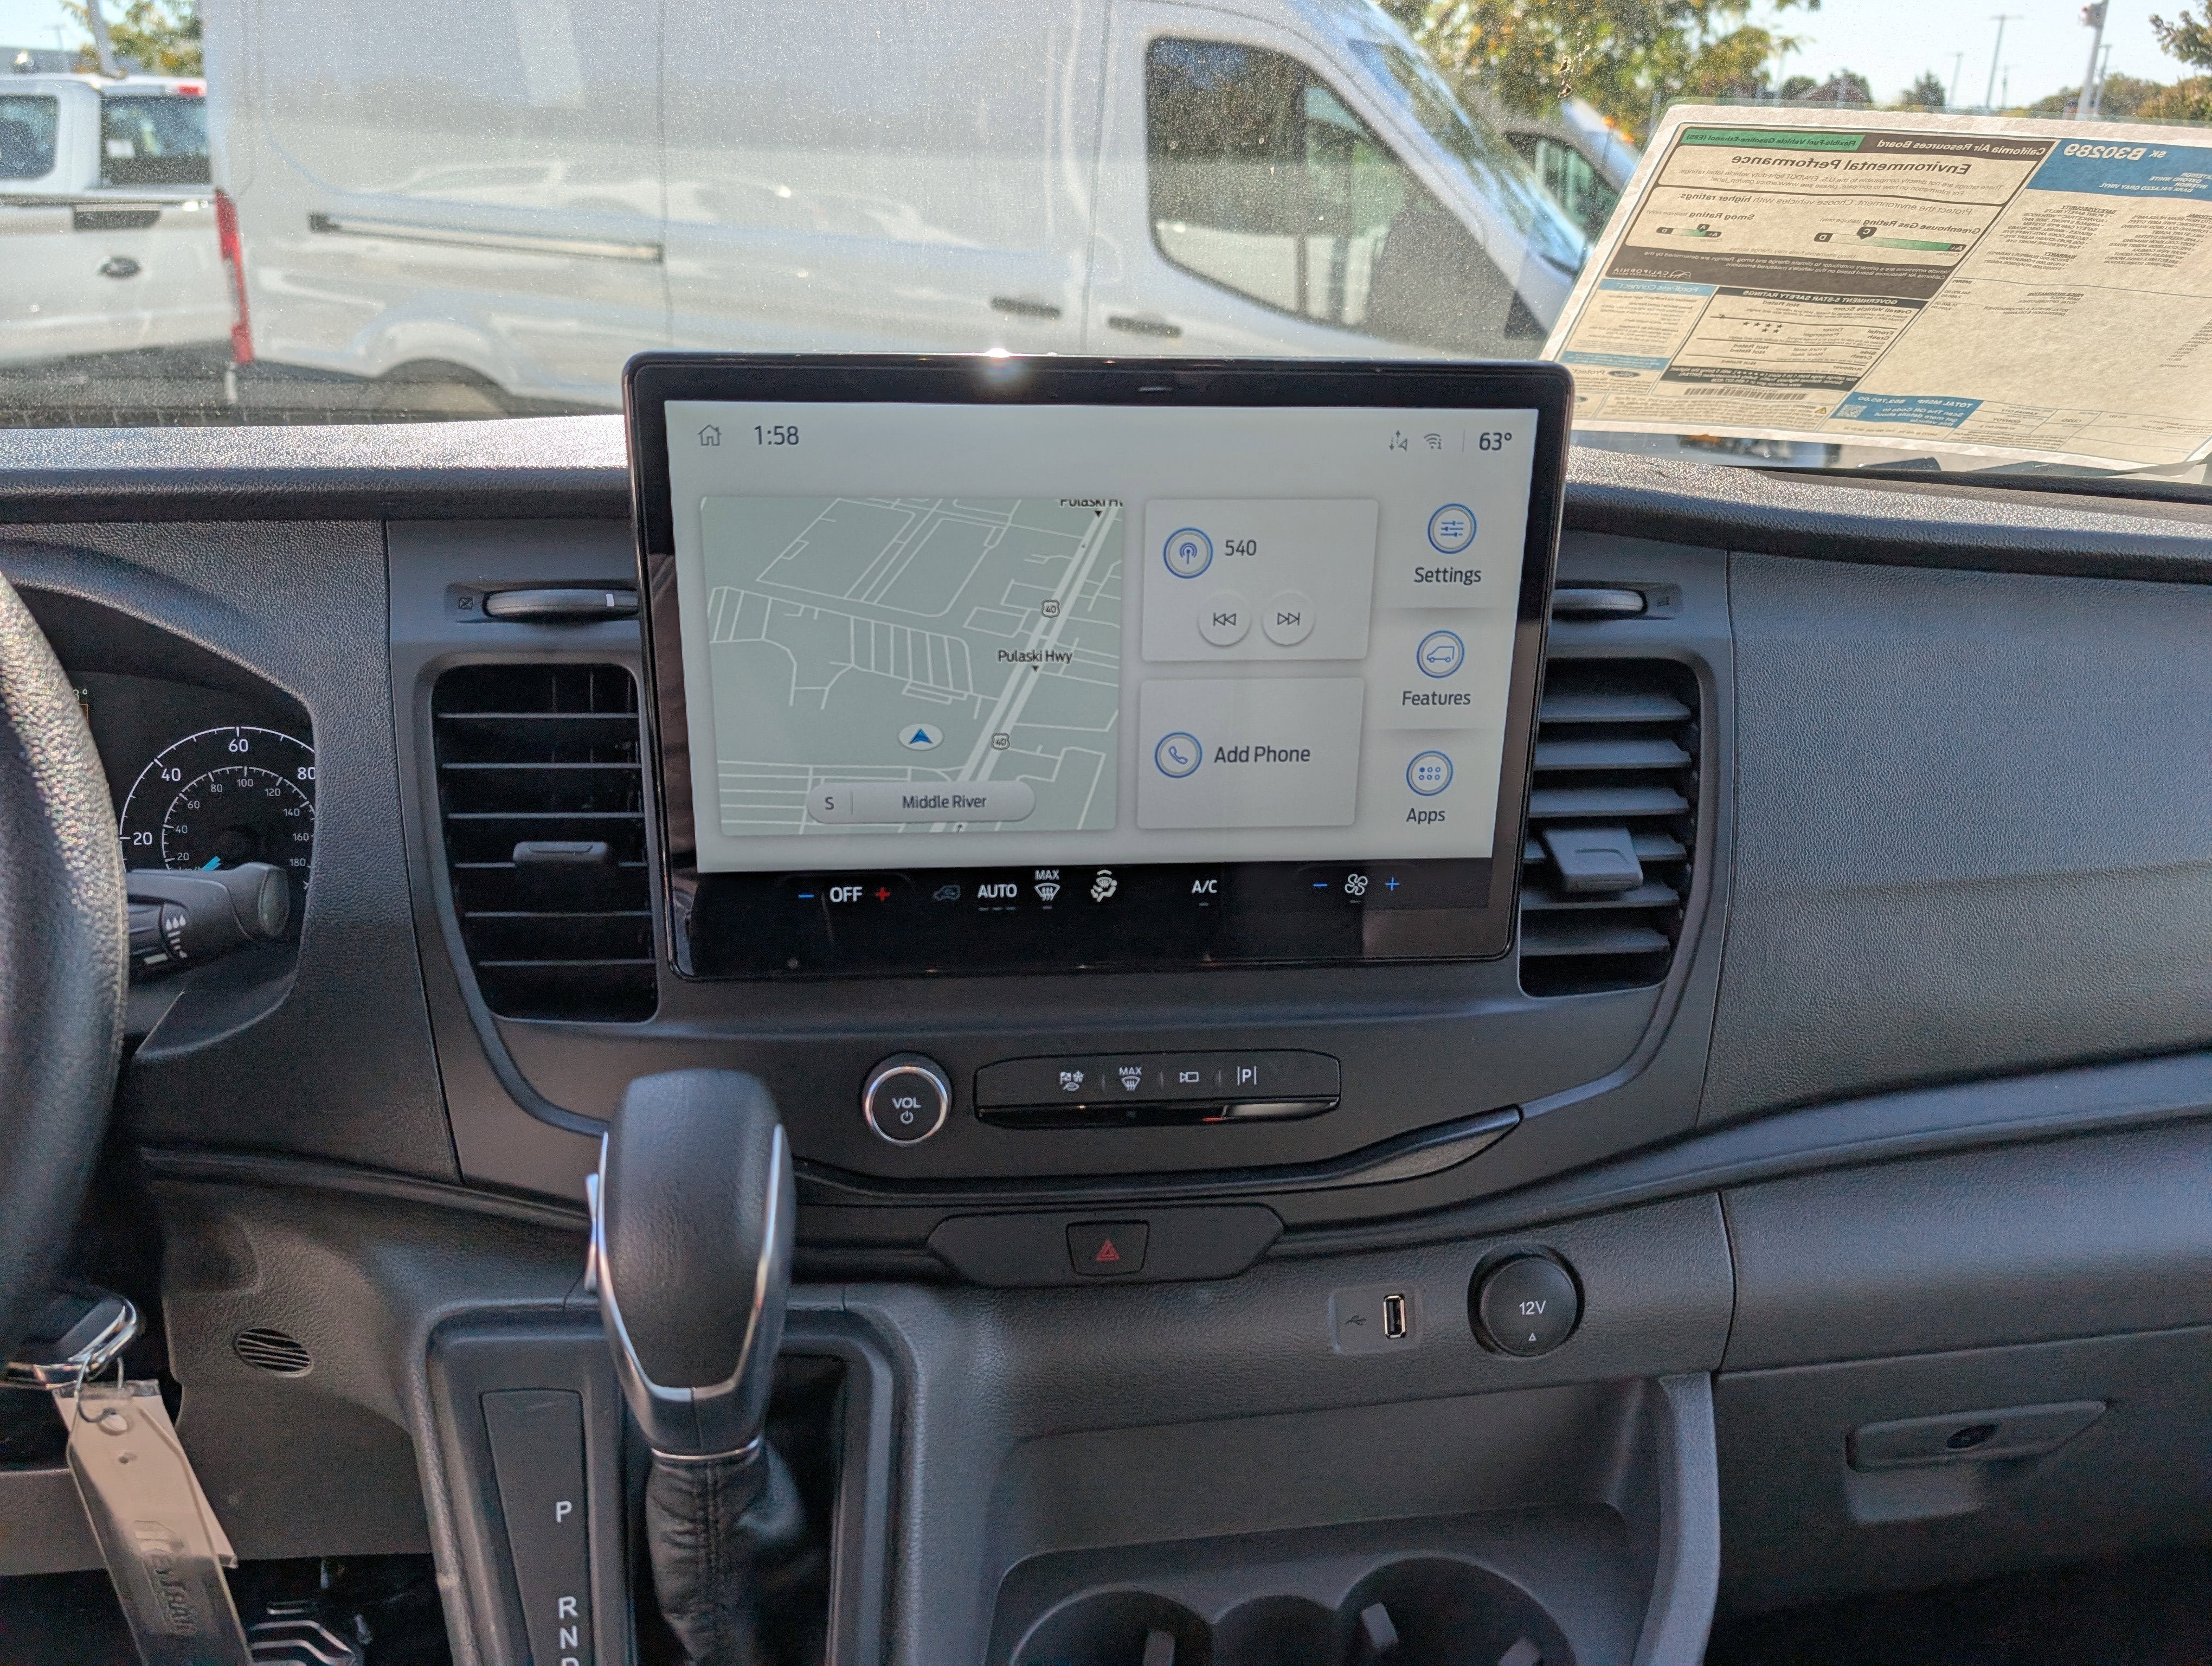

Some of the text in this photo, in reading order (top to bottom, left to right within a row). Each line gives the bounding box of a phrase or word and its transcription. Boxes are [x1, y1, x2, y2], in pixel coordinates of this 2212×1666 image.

[754, 425, 800, 446] 1:58
[1479, 432, 1512, 451] 63°
[1225, 540, 1257, 556] 540
[1414, 566, 1482, 585] Settings
[1045, 605, 1057, 614] 40
[998, 650, 1073, 665] Pulaski Hwy
[1402, 690, 1471, 707] Features
[229, 739, 249, 753] 60
[995, 738, 1006, 747] 40
[1214, 746, 1311, 763] Add Phone
[161, 768, 181, 781] 40
[298, 766, 316, 780] 80
[210, 784, 223, 793] 80
[237, 778, 254, 787] 100
[265, 788, 281, 797] 120
[188, 800, 200, 809] 60
[824, 795, 987, 810] S Middle River
[283, 808, 300, 817] 140
[1406, 808, 1446, 824] Apps
[175, 825, 188, 834] 40
[133, 832, 152, 845] 20
[292, 833, 309, 841] 160
[177, 853, 189, 861] 20
[289, 858, 306, 867] 180
[1035, 870, 1059, 881] MAX
[978, 883, 1017, 898] AUTO
[1192, 879, 1217, 894] A/C
[829, 887, 863, 902] OFF
[1119, 1067, 1142, 1076] MAX
[892, 1097, 921, 1109] VOL
[1519, 1300, 1546, 1316] 12V
[555, 1501, 572, 1523] P
[558, 1596, 578, 1619] R
[560, 1625, 578, 1649] N
